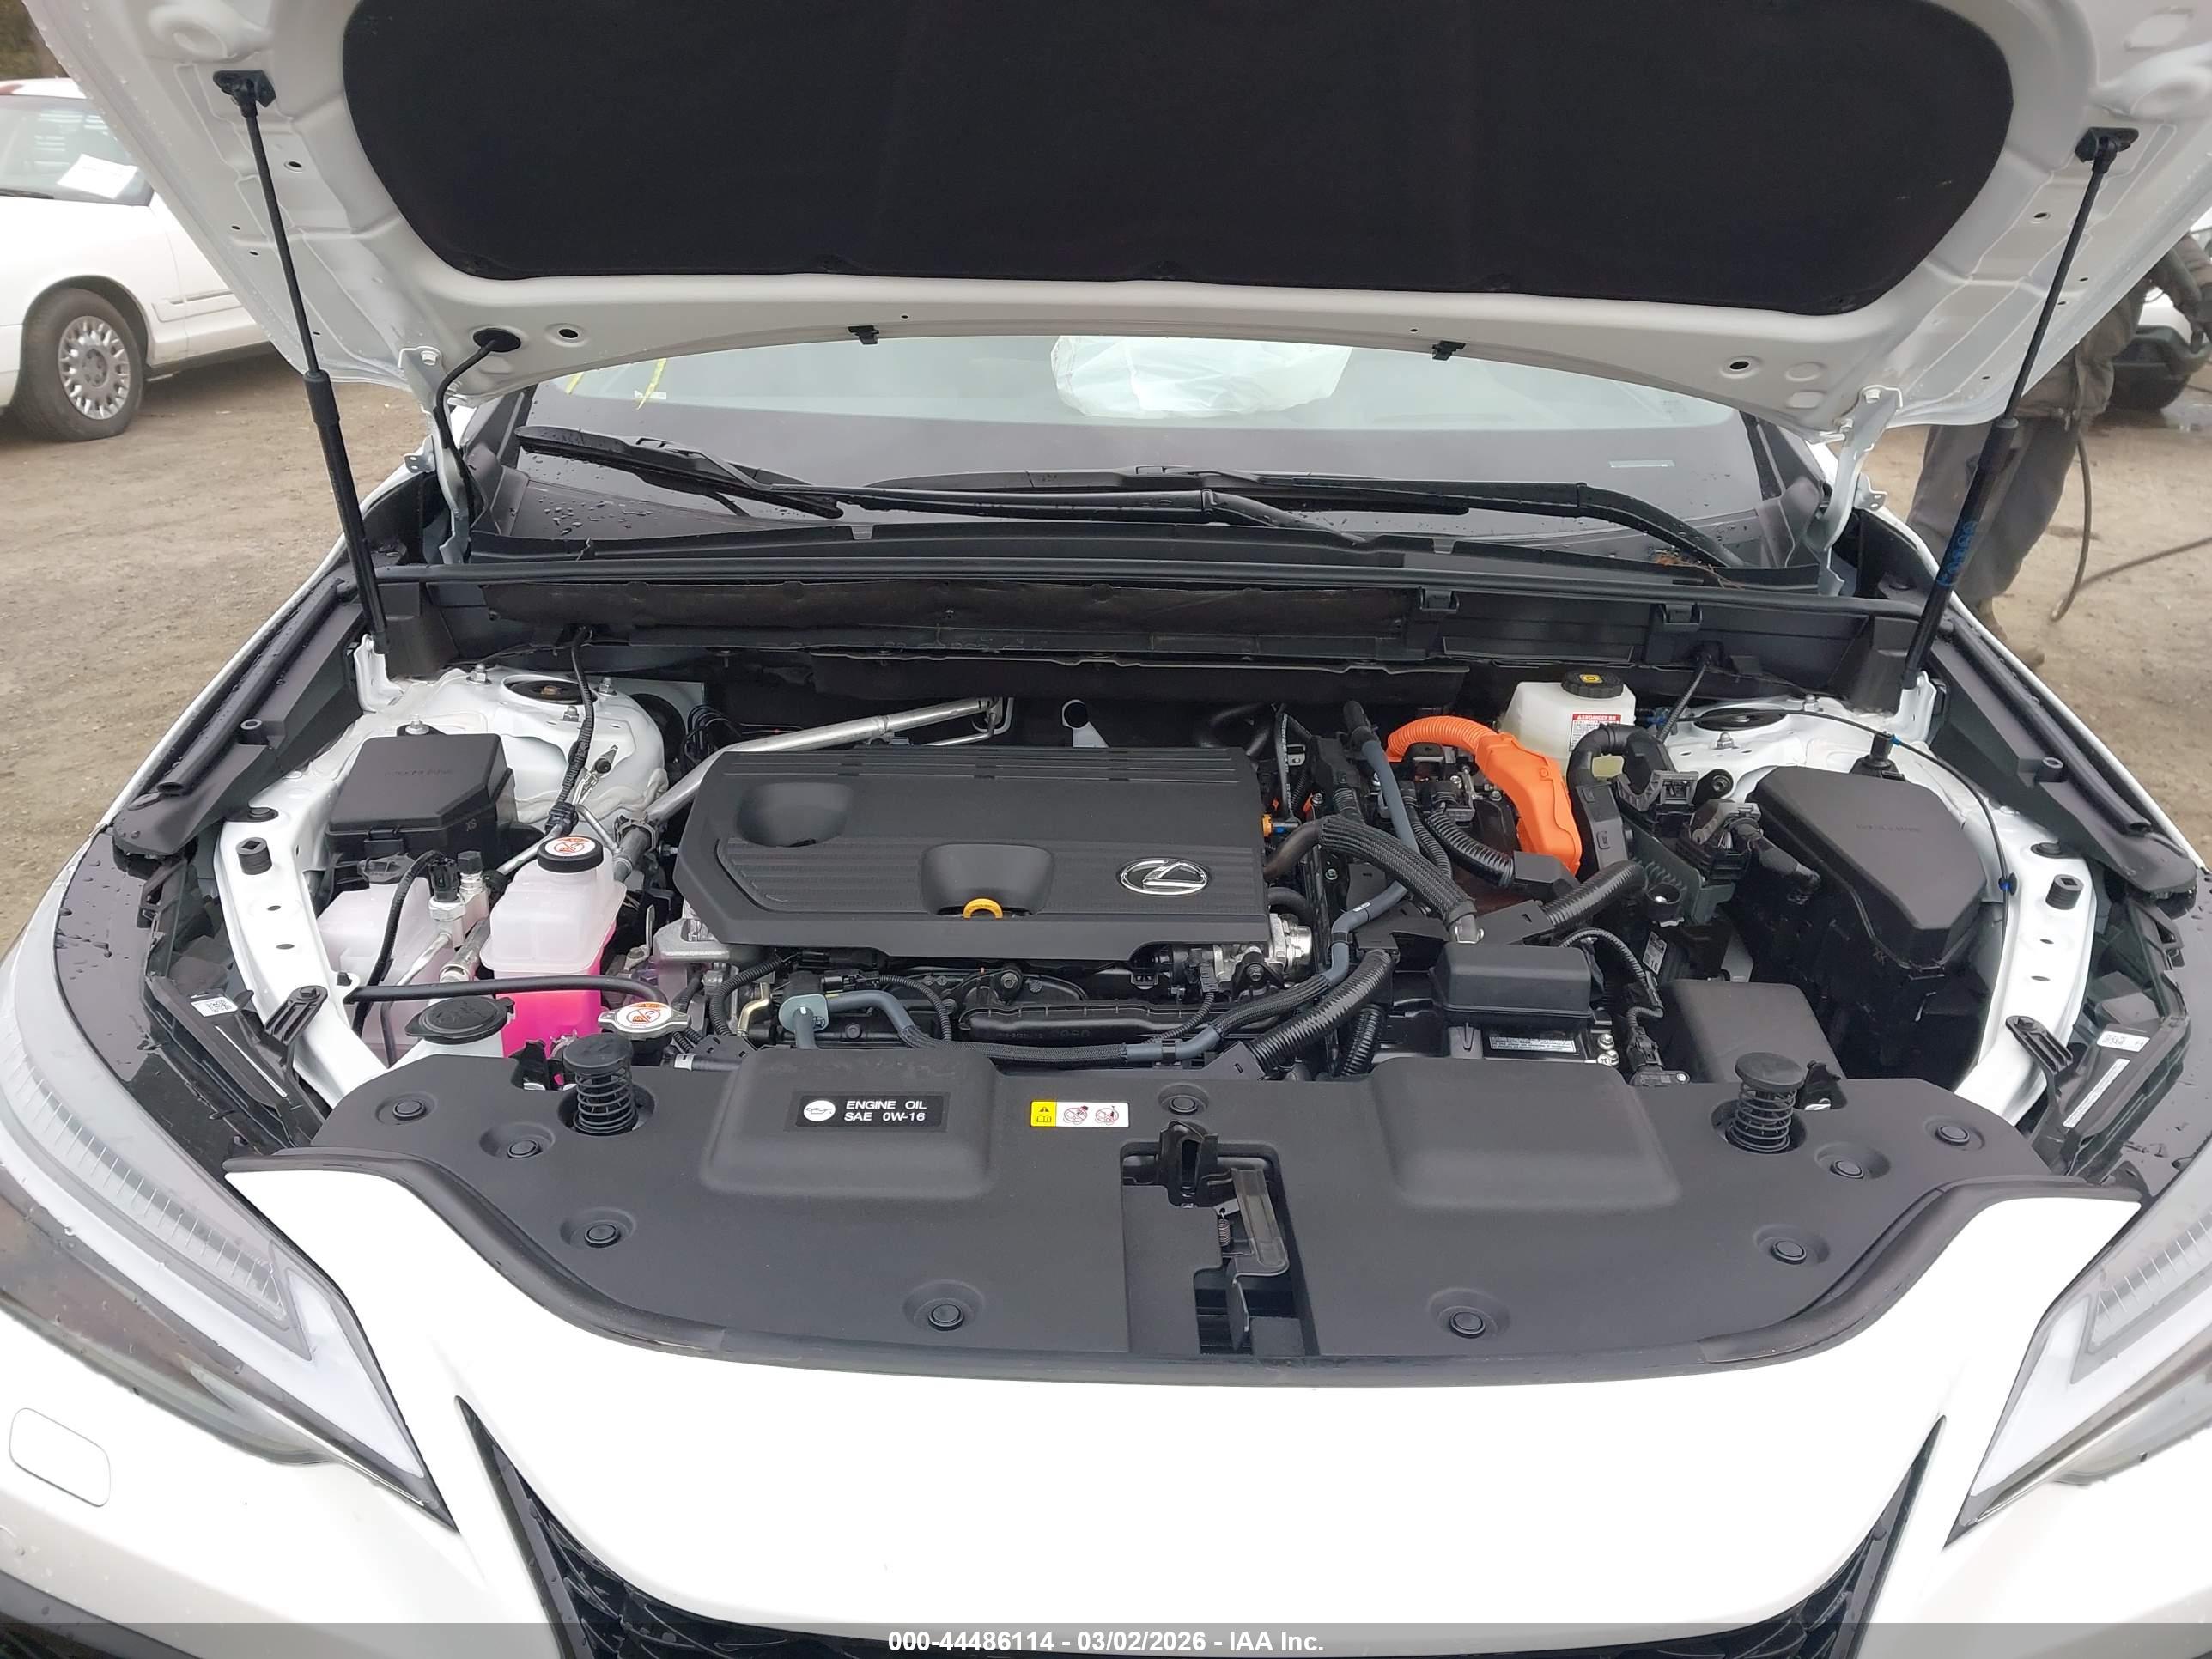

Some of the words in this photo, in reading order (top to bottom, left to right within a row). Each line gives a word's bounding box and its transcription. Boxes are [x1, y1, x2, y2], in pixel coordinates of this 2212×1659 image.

[845, 1100, 896, 1110] ENGINE
[904, 1100, 927, 1110] OIL
[843, 1112, 873, 1121] SAE
[882, 1112, 926, 1121] 0W-16
